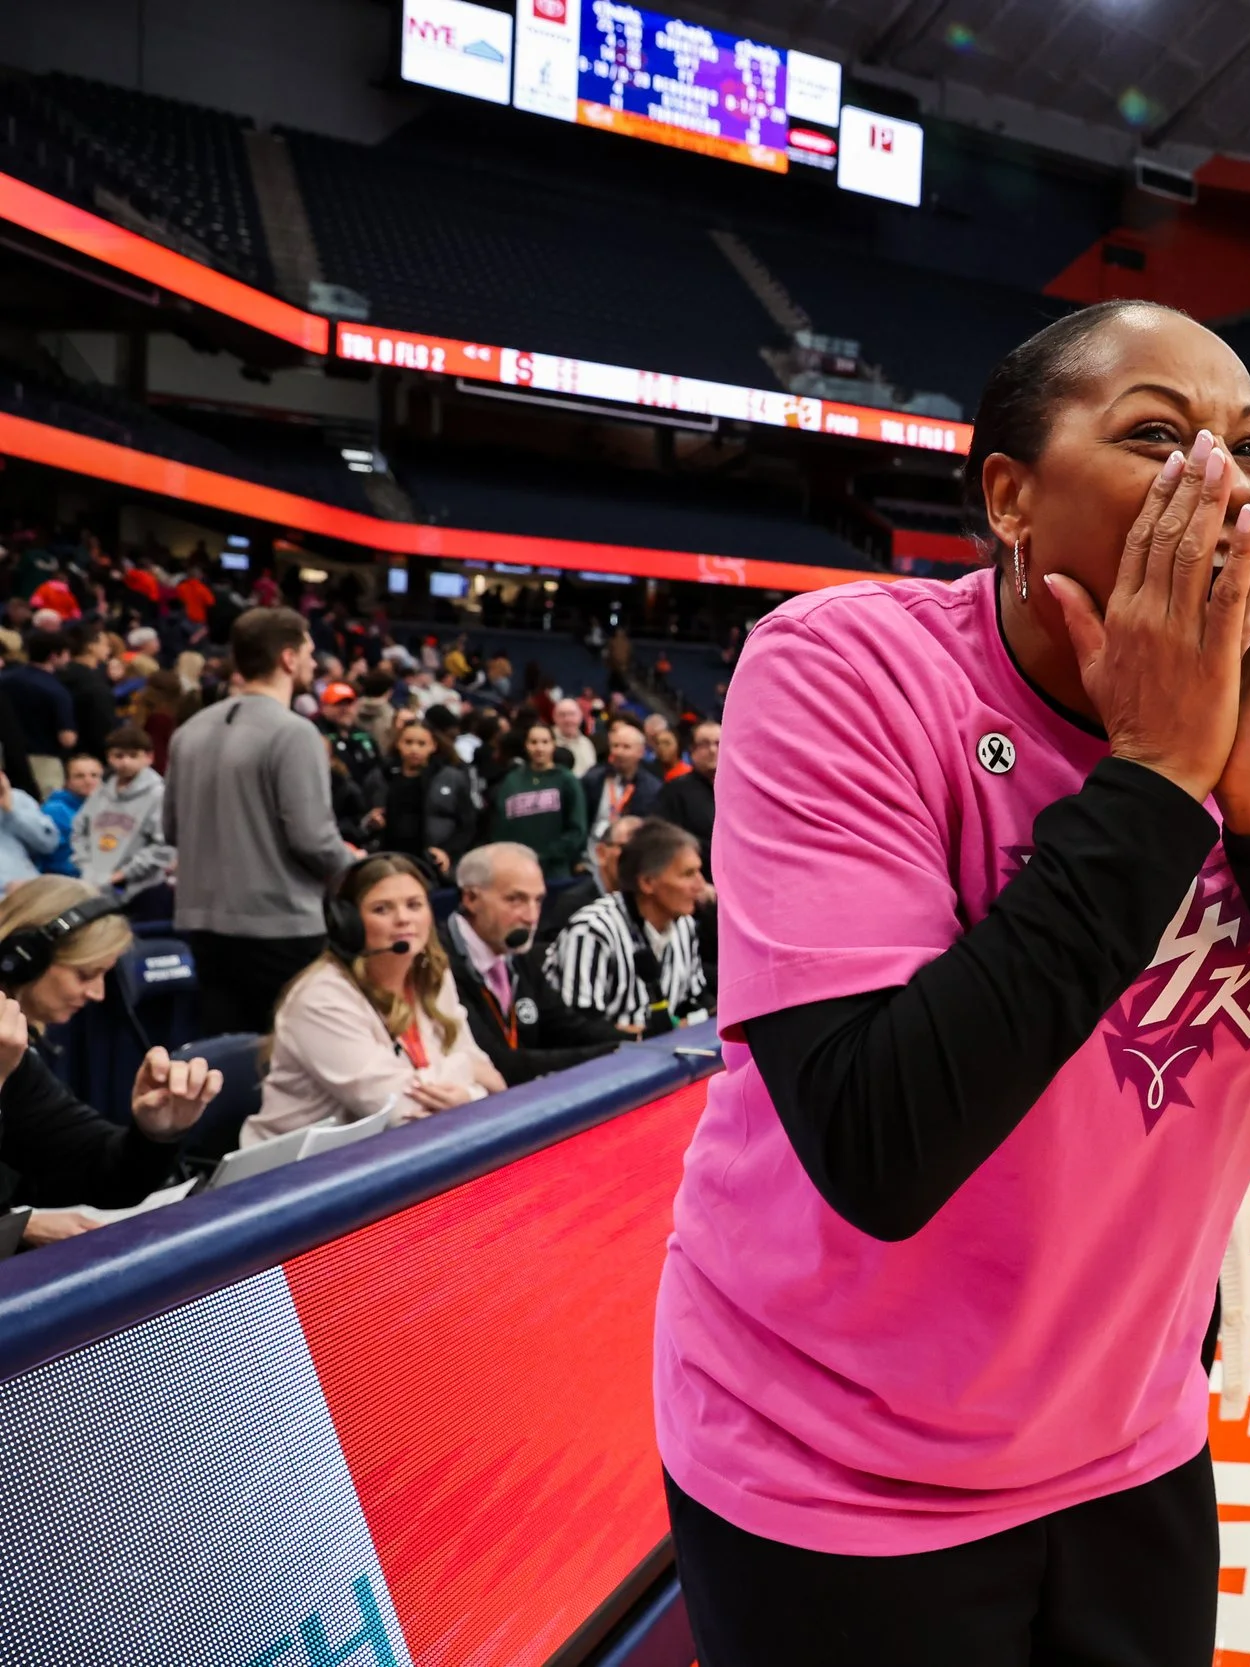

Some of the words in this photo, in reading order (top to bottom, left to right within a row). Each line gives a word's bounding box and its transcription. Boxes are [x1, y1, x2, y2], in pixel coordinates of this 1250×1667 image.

[406, 16, 457, 50] NYE
[431, 346, 446, 373] 2
[515, 352, 533, 386] S
